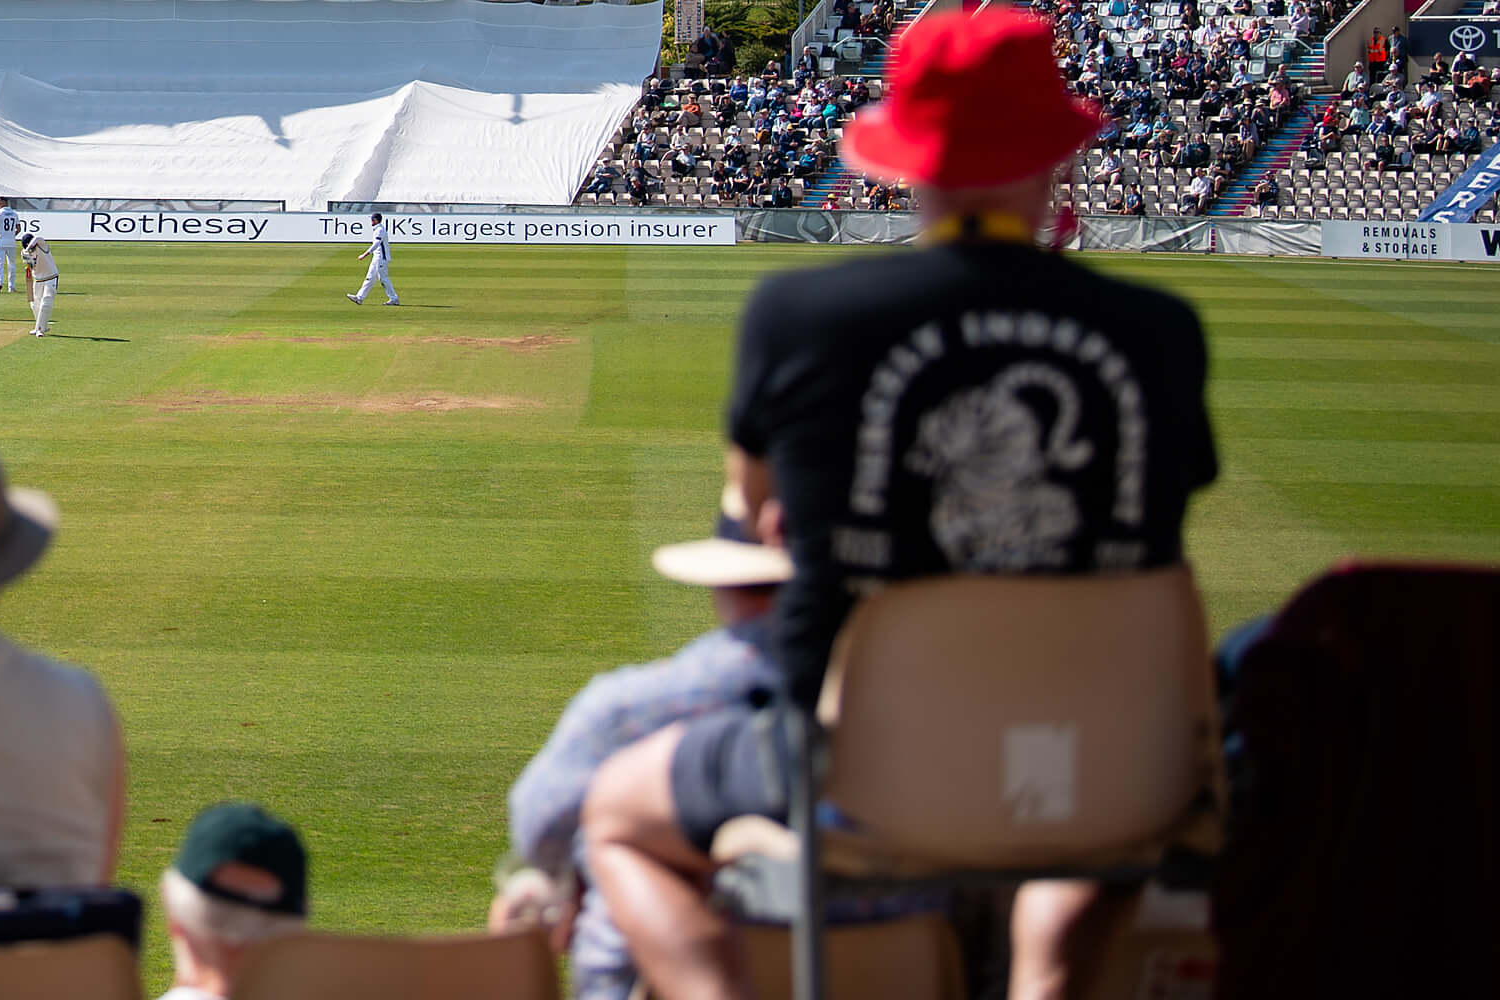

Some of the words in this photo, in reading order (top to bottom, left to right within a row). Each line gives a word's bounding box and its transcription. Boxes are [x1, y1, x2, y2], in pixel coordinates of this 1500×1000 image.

[4, 218, 16, 232] 87
[89, 212, 269, 240] Rothesay
[319, 217, 363, 235] The
[432, 217, 515, 241] largest
[524, 217, 621, 242] pension
[630, 219, 718, 238] insurer
[1363, 227, 1437, 239] REMOVALS
[1362, 242, 1370, 253] &
[1375, 242, 1438, 255] STORAGE
